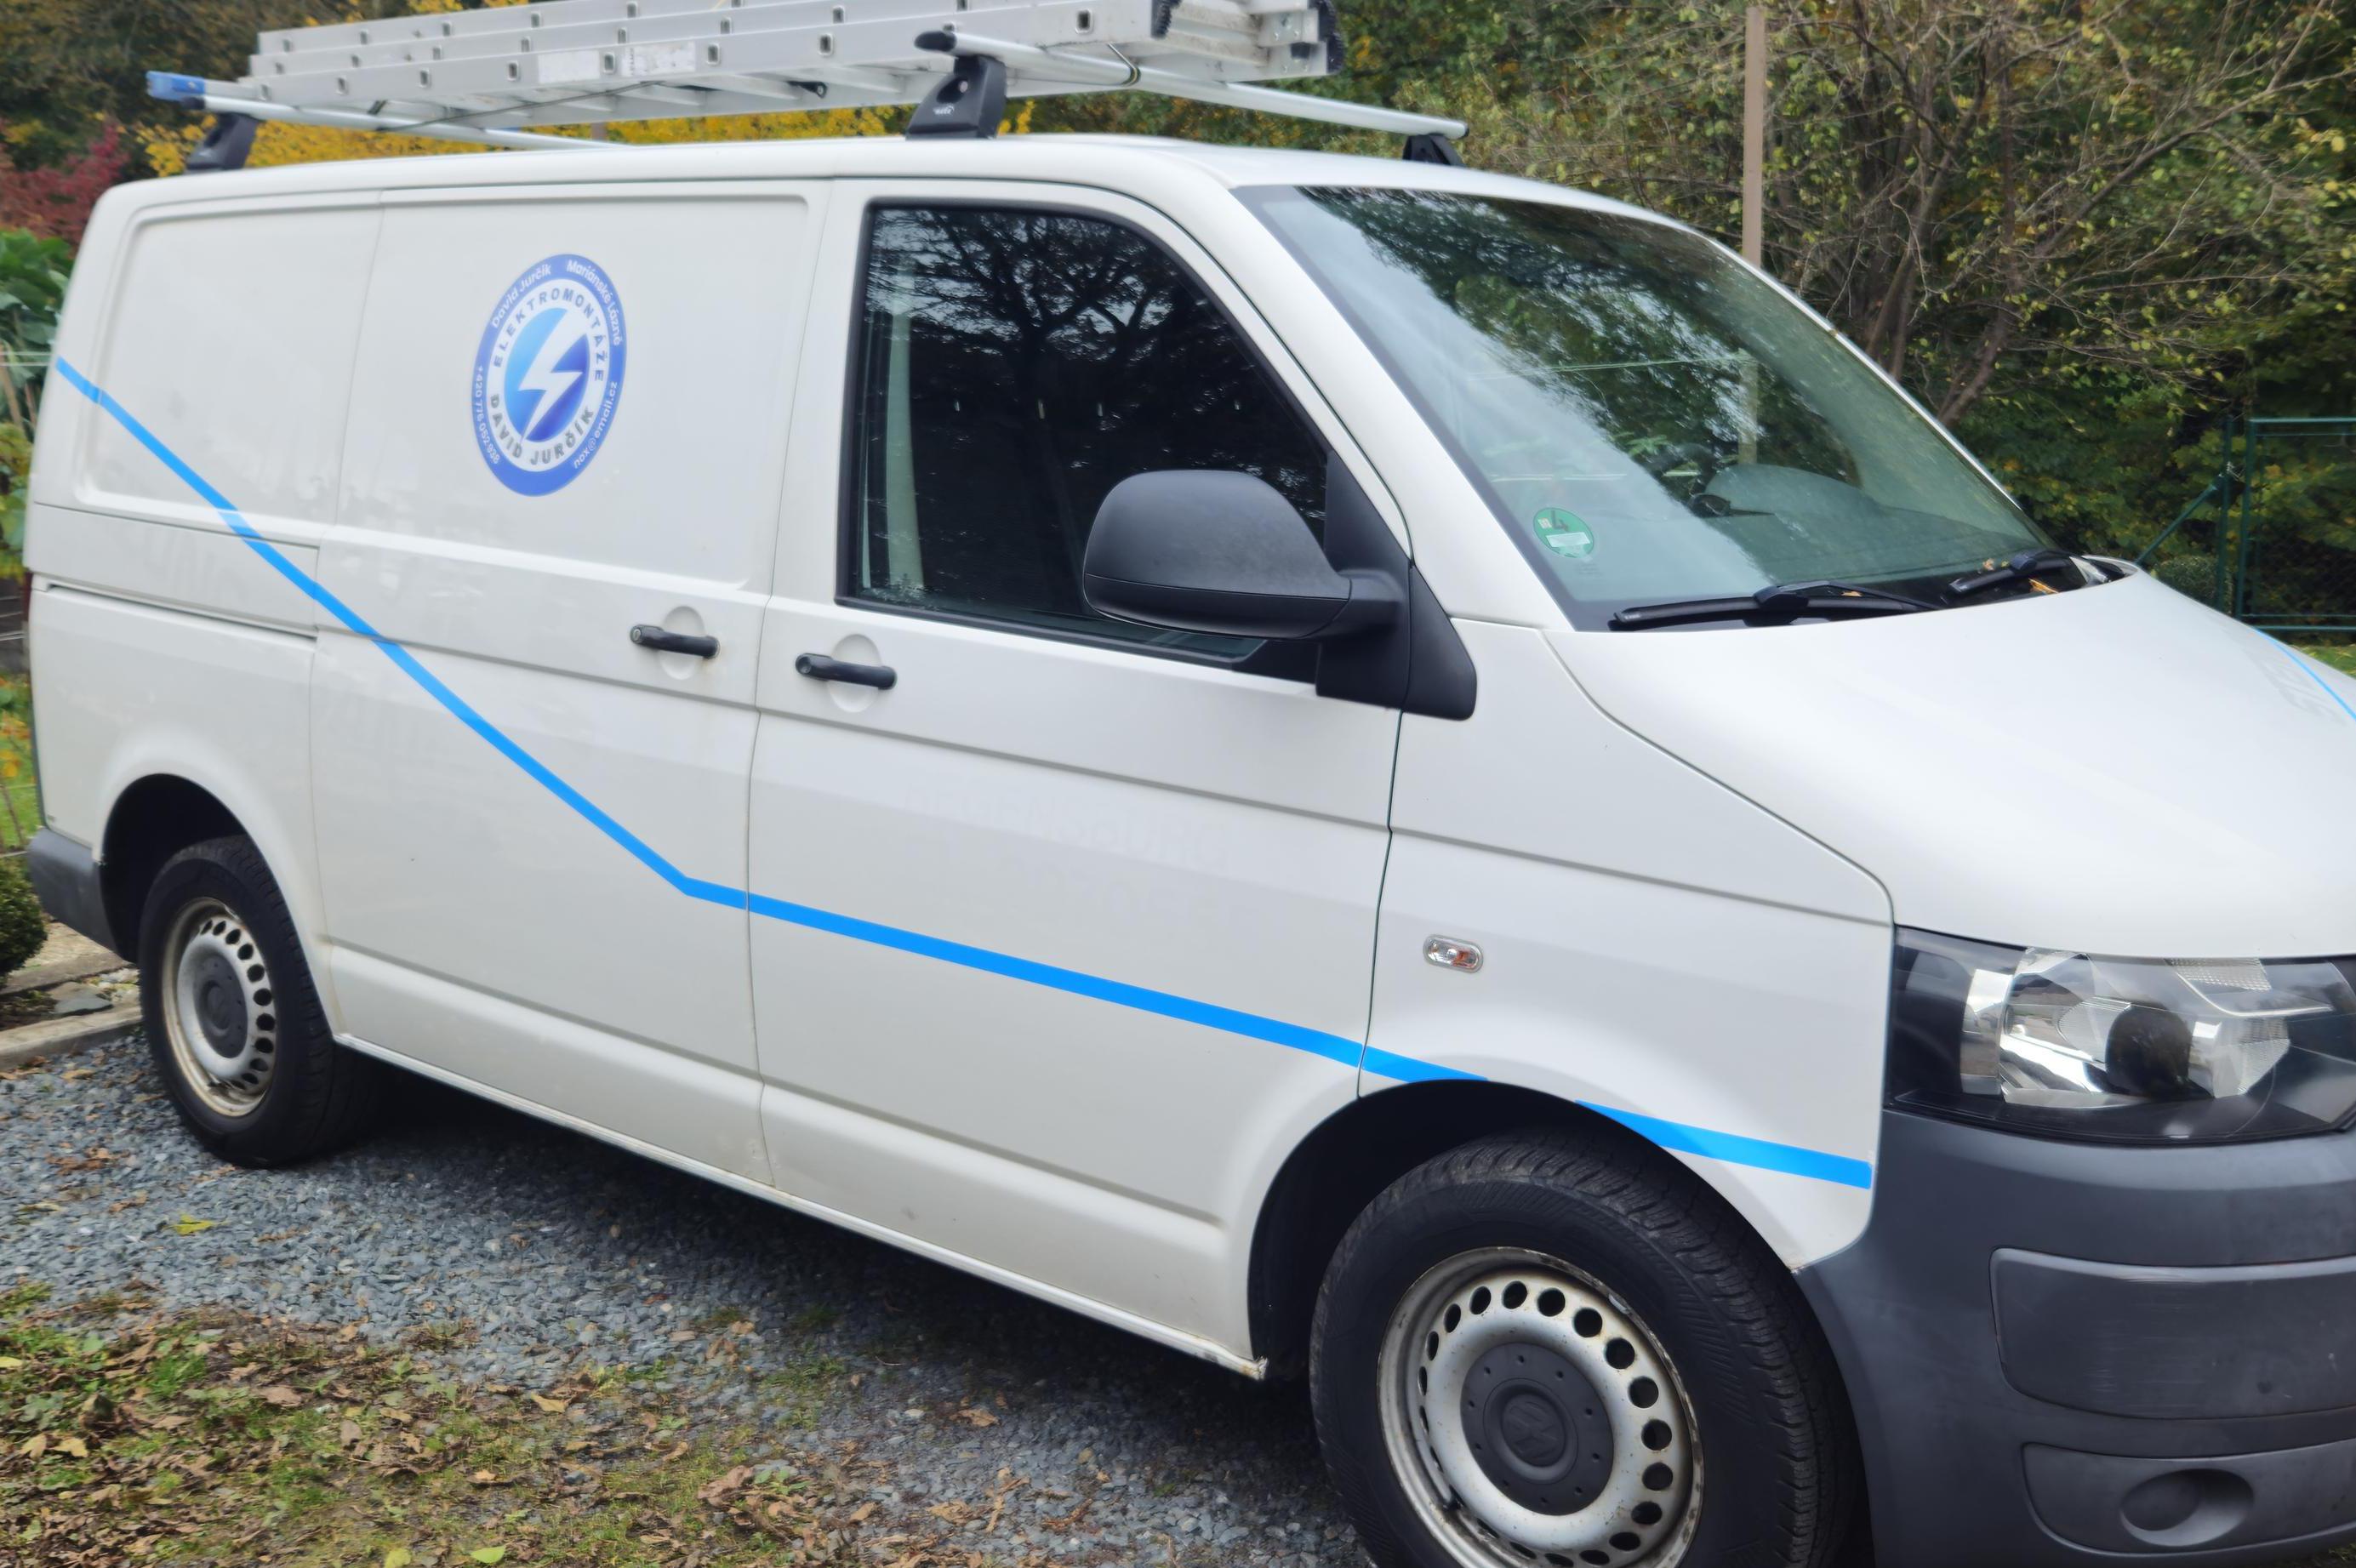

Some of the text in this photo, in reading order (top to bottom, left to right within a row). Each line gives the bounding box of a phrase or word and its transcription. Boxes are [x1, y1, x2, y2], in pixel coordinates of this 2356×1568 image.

[492, 288, 519, 328] David
[493, 288, 608, 381] ELEKTROMONTÁŽE
[490, 394, 594, 465] DAVID JURČÍK
[1551, 510, 1570, 532] 4
